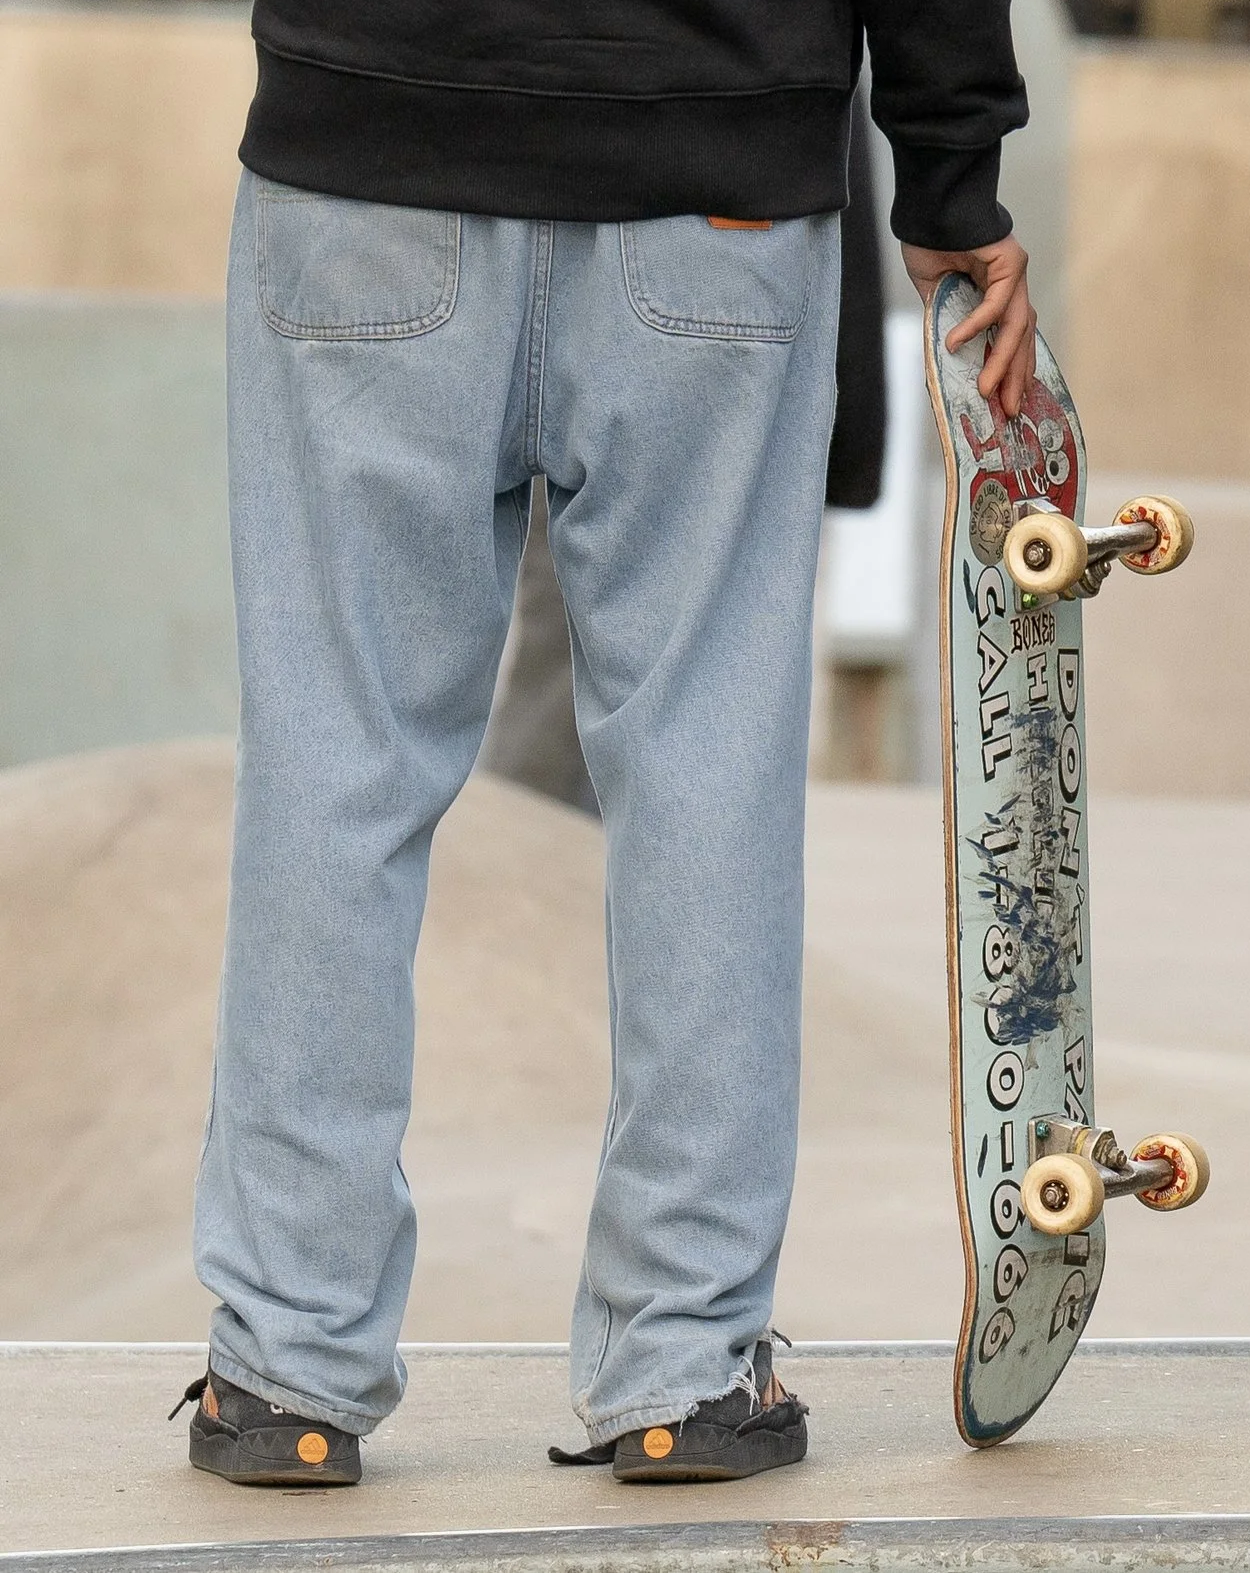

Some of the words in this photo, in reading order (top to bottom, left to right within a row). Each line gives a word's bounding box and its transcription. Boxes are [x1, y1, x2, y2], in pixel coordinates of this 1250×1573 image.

[983, 483, 999, 498] LIBRE
[975, 566, 1013, 782] CALL
[1010, 611, 1056, 654] BONES
[1048, 1035, 1090, 1344] PAIC
